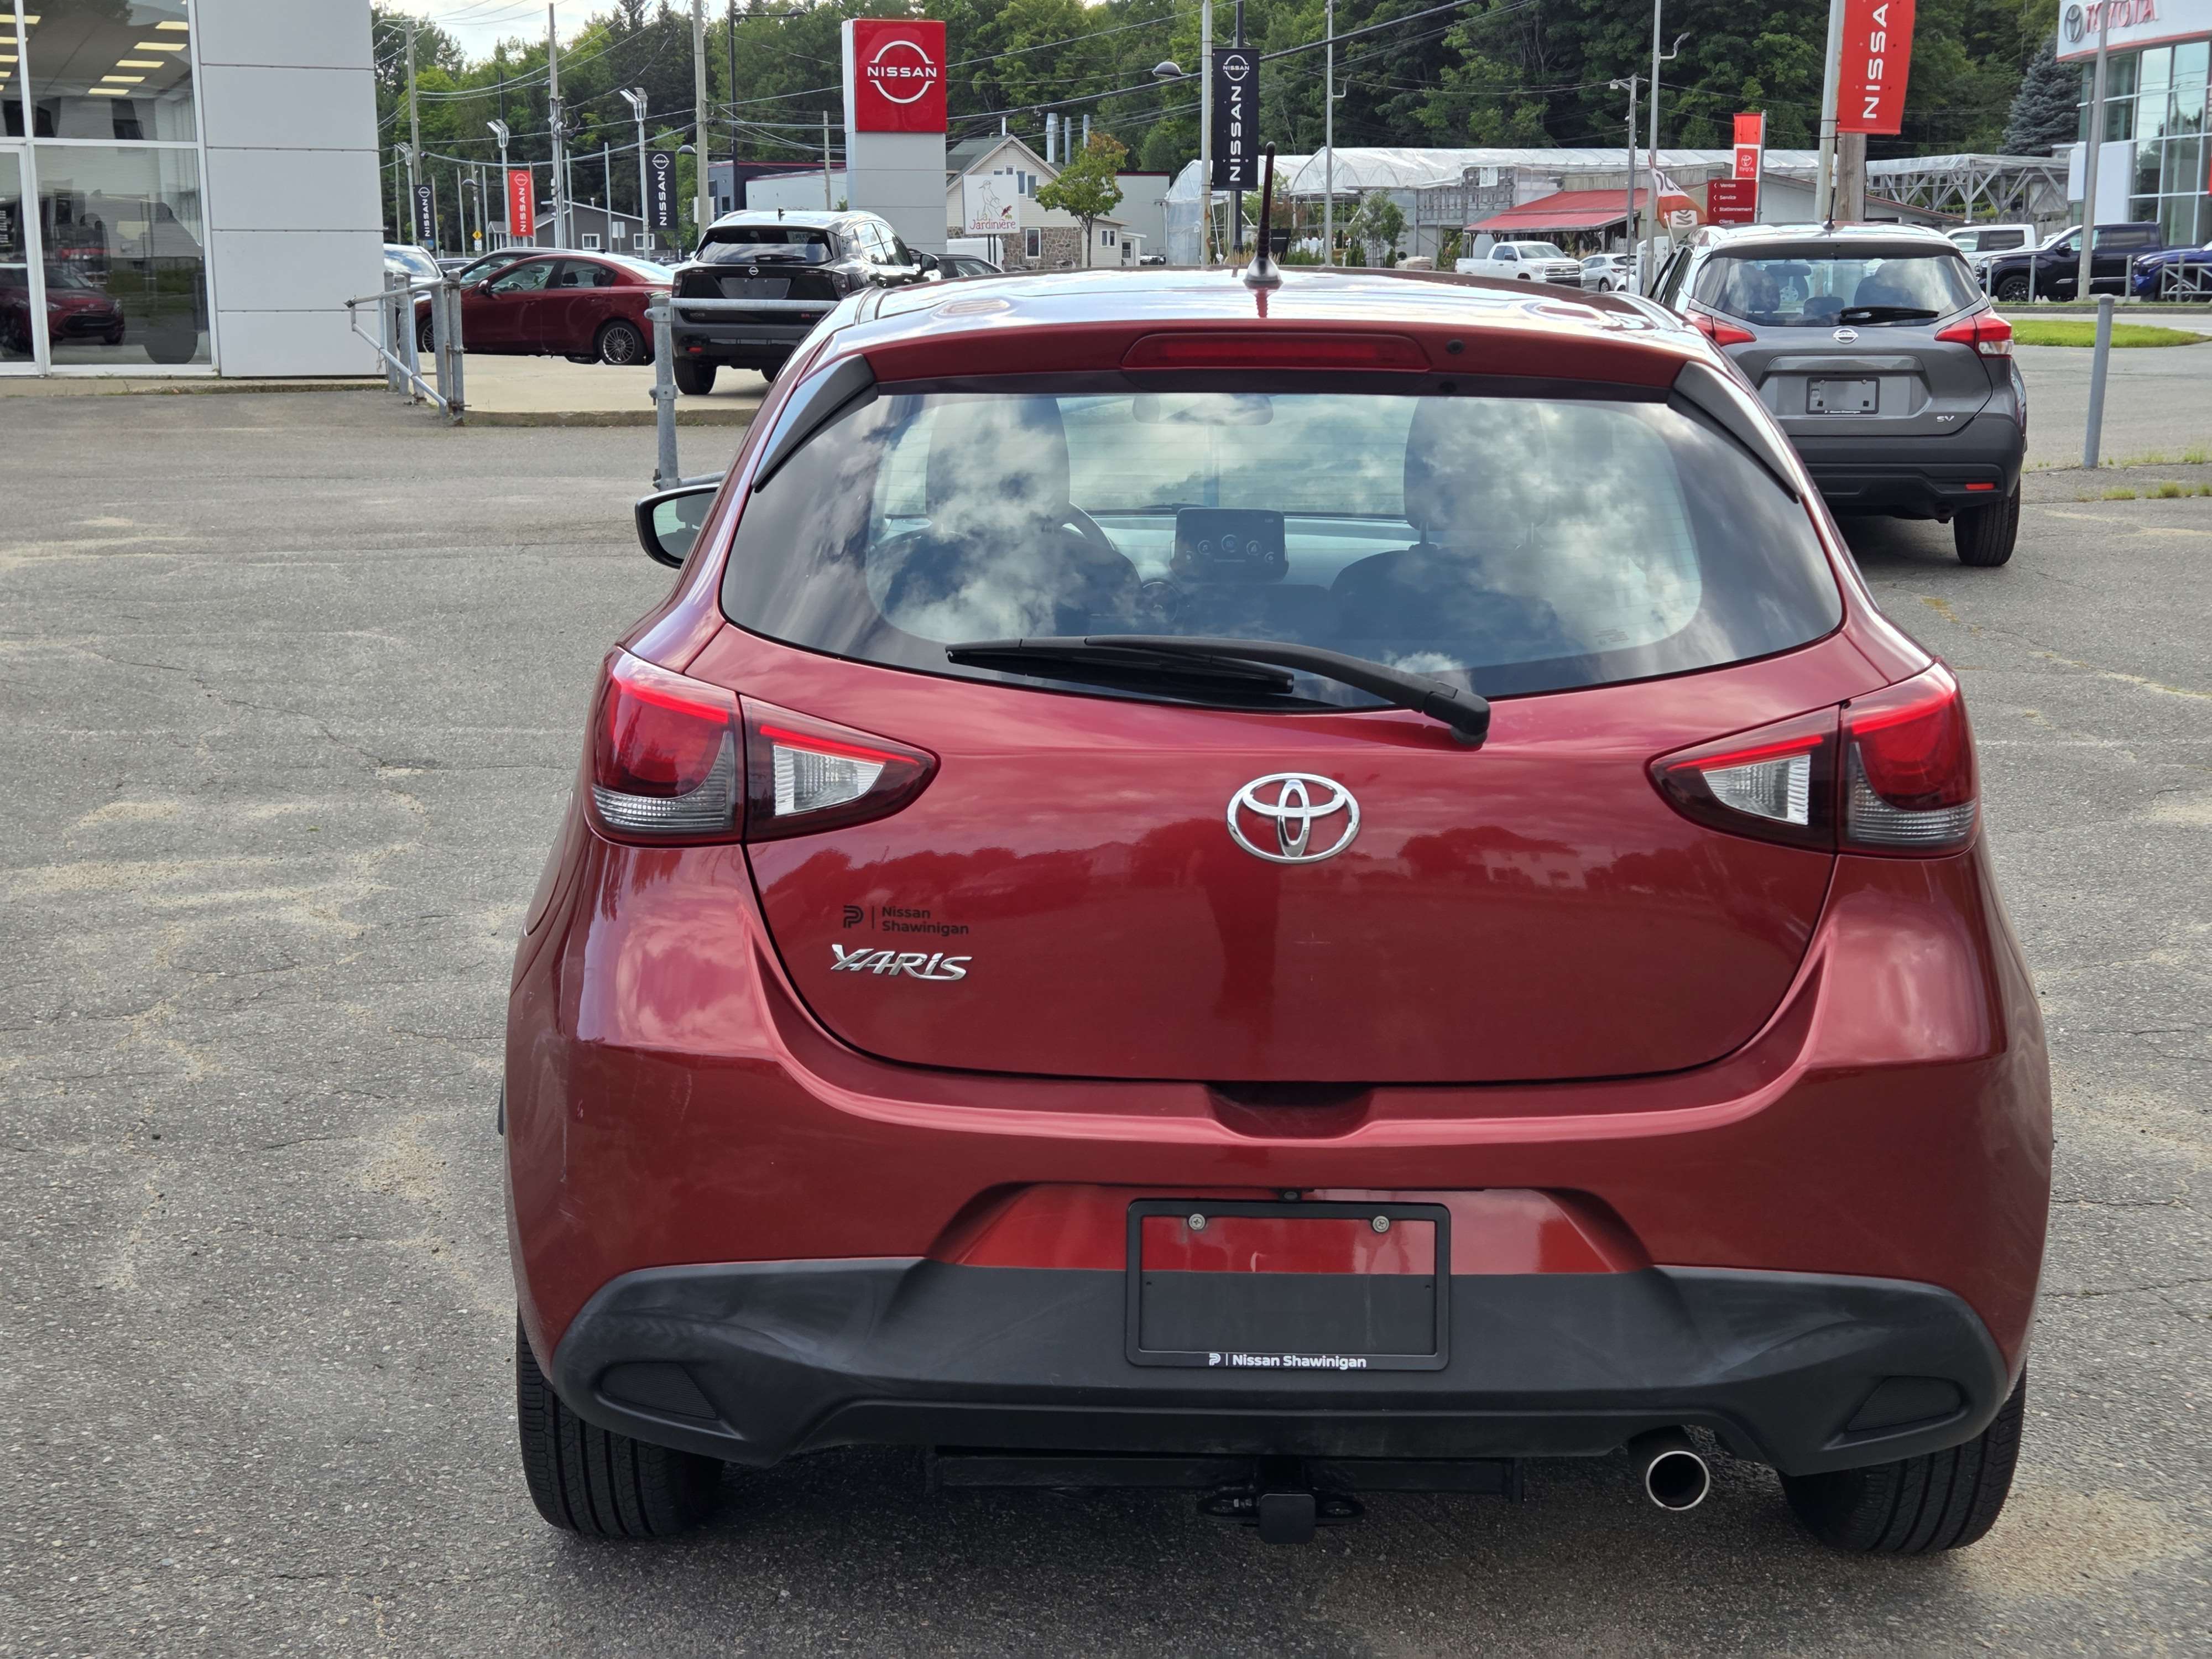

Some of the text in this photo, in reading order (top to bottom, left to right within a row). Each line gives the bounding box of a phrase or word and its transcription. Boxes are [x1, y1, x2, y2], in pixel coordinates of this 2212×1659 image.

[867, 66, 937, 77] NISSAN
[1229, 86, 1242, 182] NISSAN
[656, 171, 667, 226] NISSAN
[422, 199, 431, 237] NISSAN
[519, 187, 527, 232] NISSAN
[977, 210, 988, 221] La
[969, 218, 1016, 230] Jardinière
[882, 906, 930, 919] Nissan
[882, 920, 969, 937] Shawinigan
[831, 943, 973, 981] YARIS
[1232, 1354, 1280, 1366] Nissan
[1282, 1355, 1367, 1370] Shawinigan
